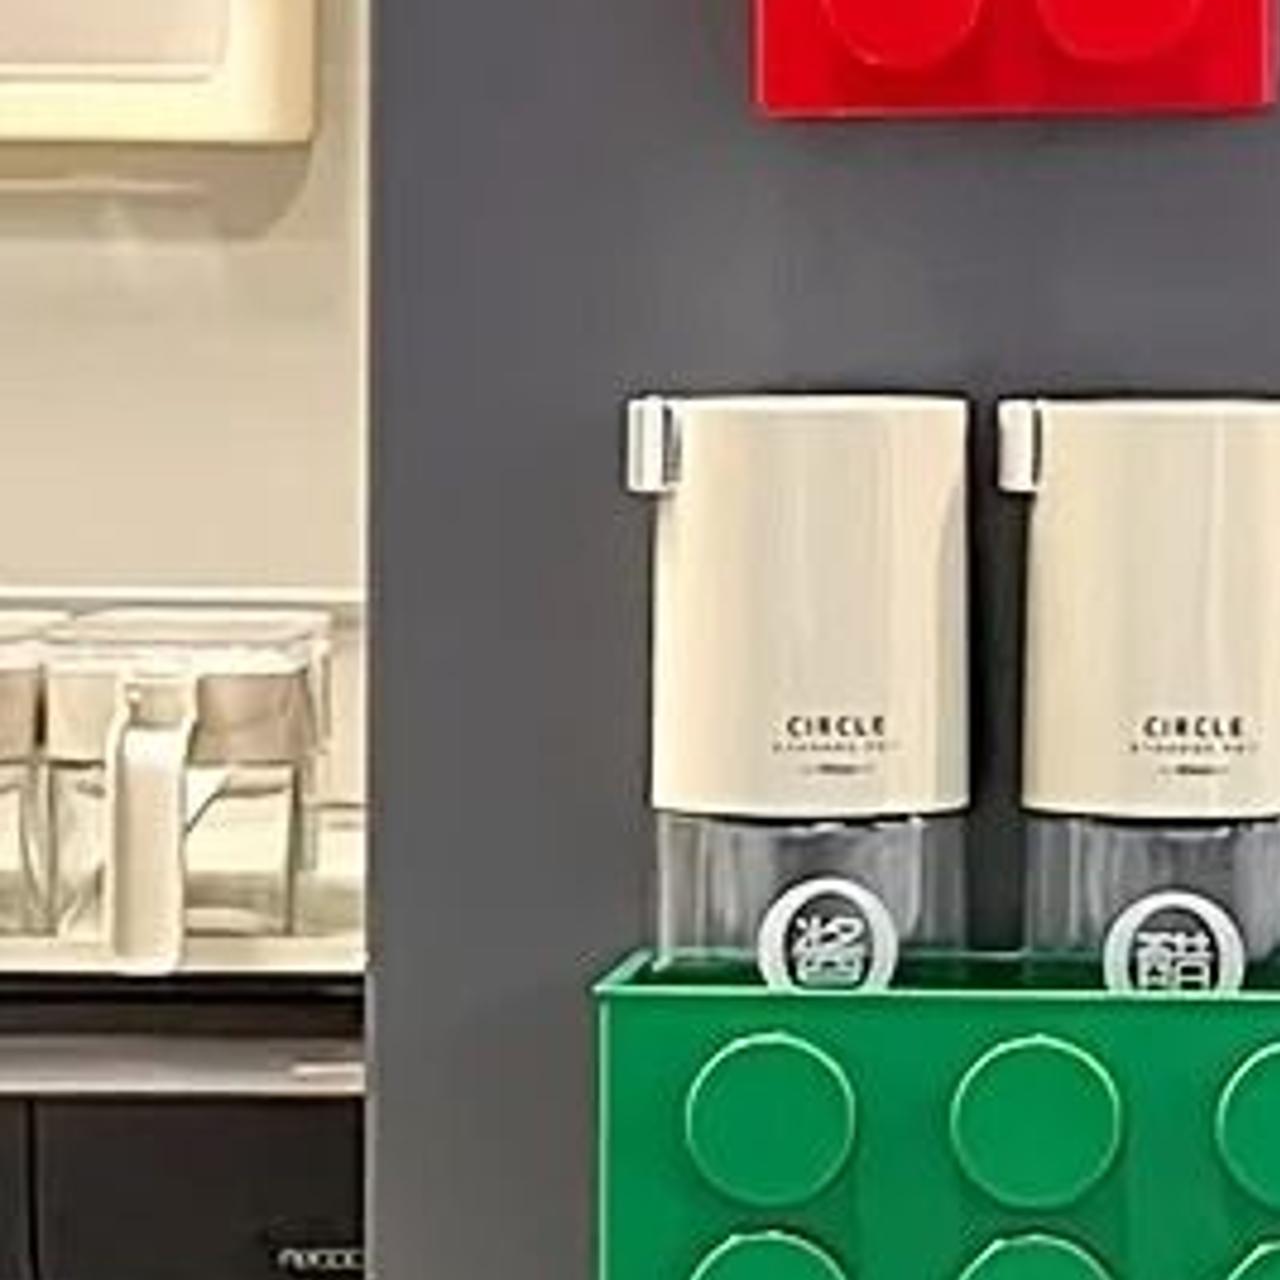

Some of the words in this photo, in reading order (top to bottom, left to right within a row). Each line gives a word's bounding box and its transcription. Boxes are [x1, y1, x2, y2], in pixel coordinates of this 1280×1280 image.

[785, 715, 885, 737] CIRCLE
[1142, 715, 1242, 738] CIRCLE
[1137, 931, 1211, 992] 醋
